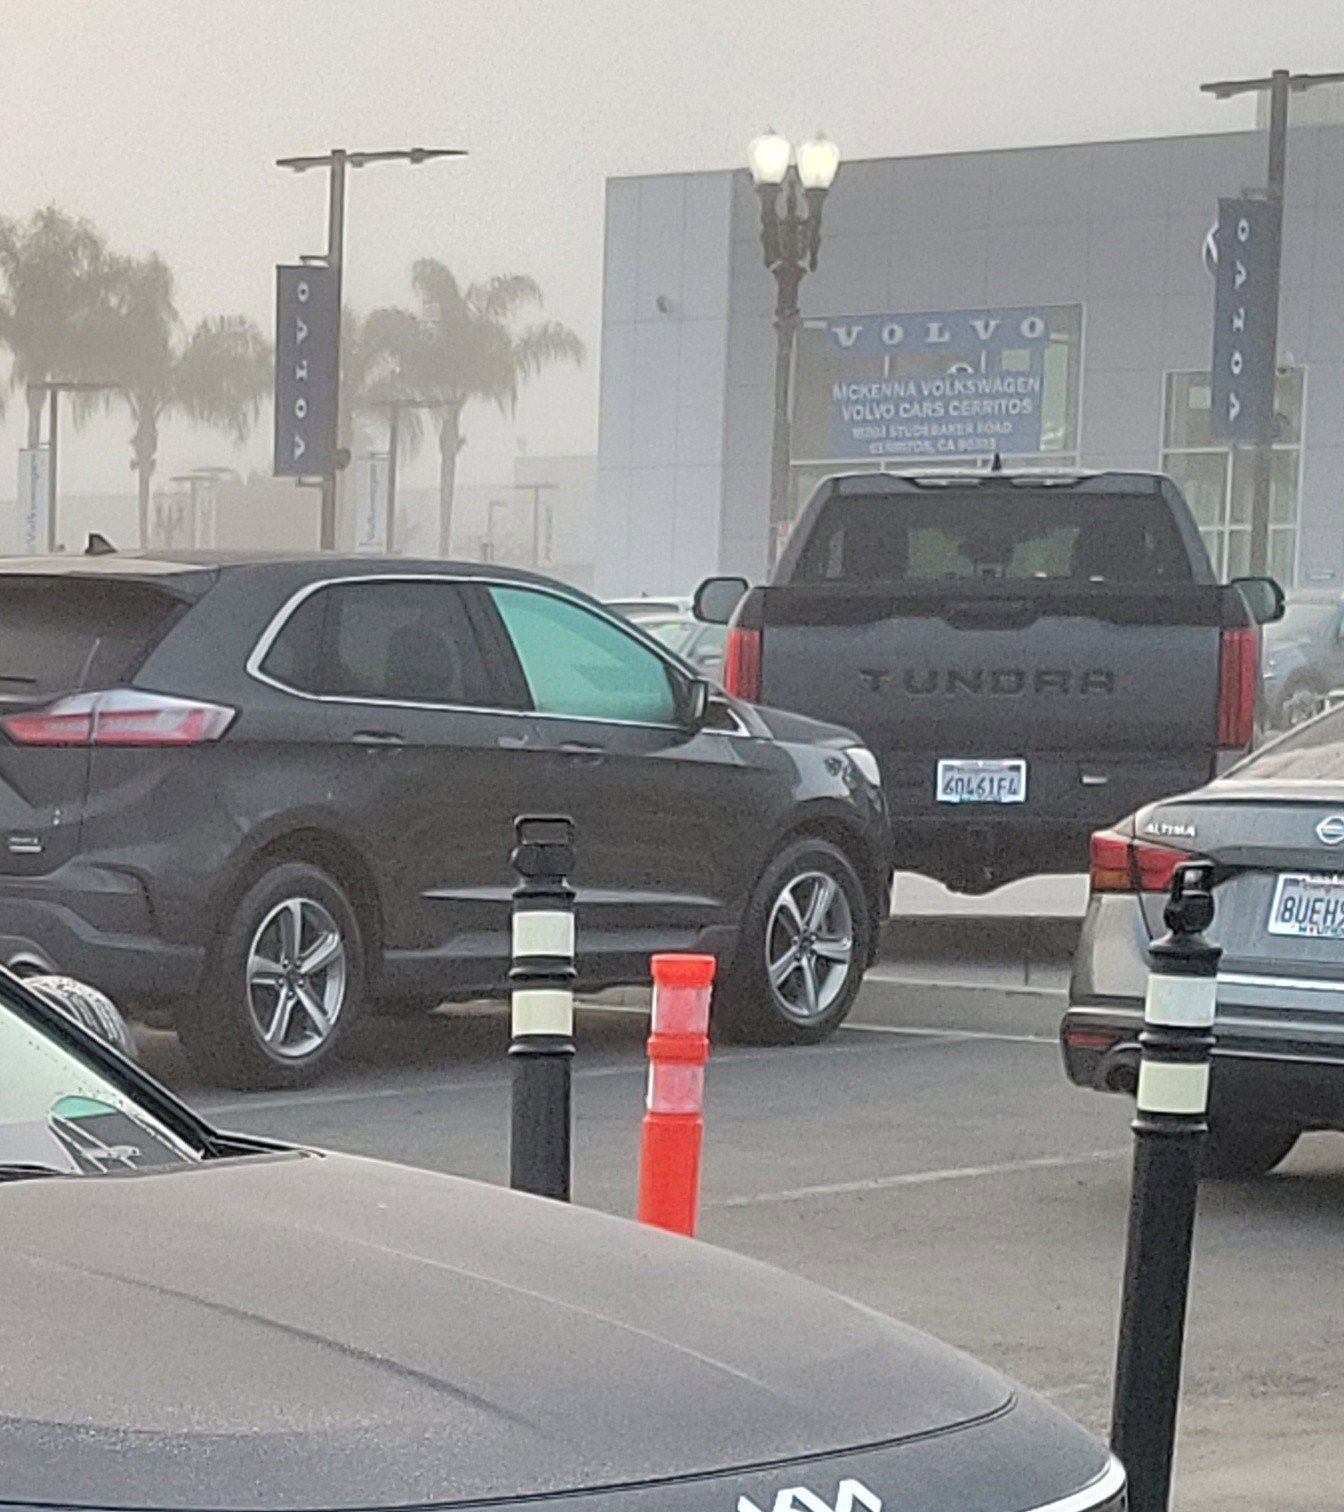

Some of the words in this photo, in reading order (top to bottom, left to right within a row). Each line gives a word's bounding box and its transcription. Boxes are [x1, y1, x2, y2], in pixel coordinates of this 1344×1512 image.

[831, 316, 1046, 348] VOLVO
[1229, 217, 1250, 422] VOLVO
[293, 280, 310, 461] VOLVO
[832, 381, 917, 401] MCKENNA
[920, 375, 1042, 397] VOLKSWAGEN
[841, 402, 895, 421] VOLVO
[898, 401, 946, 419] CARS
[948, 398, 1034, 417] CERRITOS
[858, 668, 1115, 699] TUNDRA
[1145, 822, 1196, 837] ALTIMA
